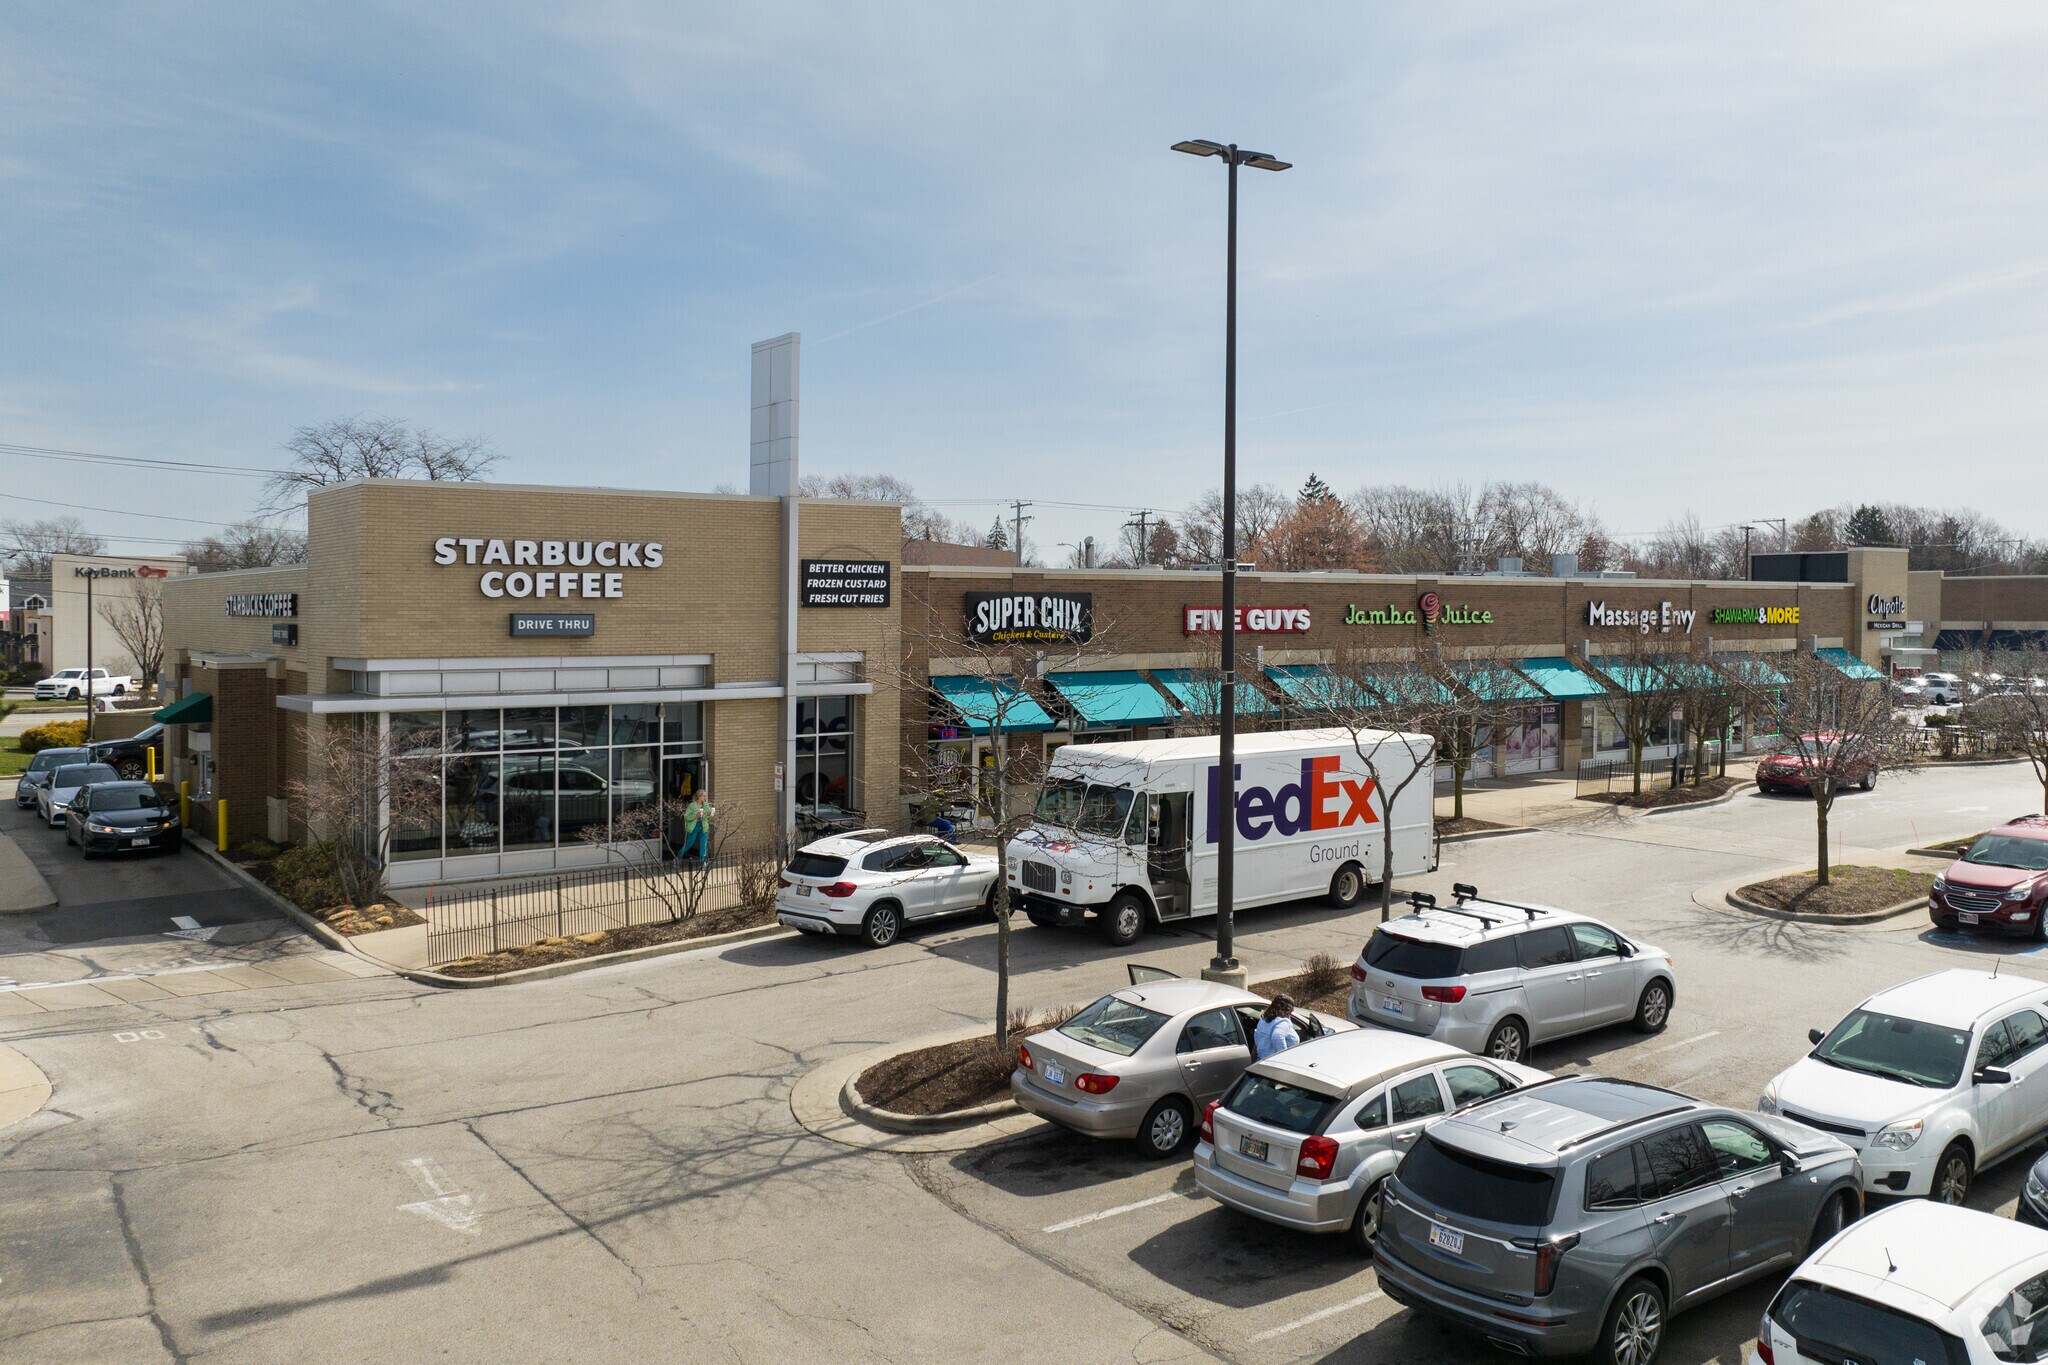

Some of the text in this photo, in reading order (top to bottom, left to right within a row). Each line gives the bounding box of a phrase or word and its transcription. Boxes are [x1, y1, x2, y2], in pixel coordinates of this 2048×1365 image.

[434, 537, 664, 568] STARBUCKS
[809, 564, 885, 574] BETTER CHICKEN
[480, 571, 623, 598] COFFEE
[807, 579, 887, 588] FROZEN CUSTARD
[225, 593, 292, 617] STARBUCKS COFFEE
[809, 594, 885, 603] FRESH CUT FRIES
[1870, 594, 1906, 619] Chipotle
[518, 619, 590, 630] DRIVE THRU
[976, 596, 1082, 634] SUPER CHIX
[1246, 608, 1311, 631] GUYS
[1344, 604, 1494, 625] Jamba Juice
[1589, 601, 1697, 635] Massage Envy
[993, 631, 1025, 641] Chicken
[1026, 630, 1032, 638] &
[1206, 755, 1380, 844] FedEx
[1310, 840, 1359, 863] Ground
